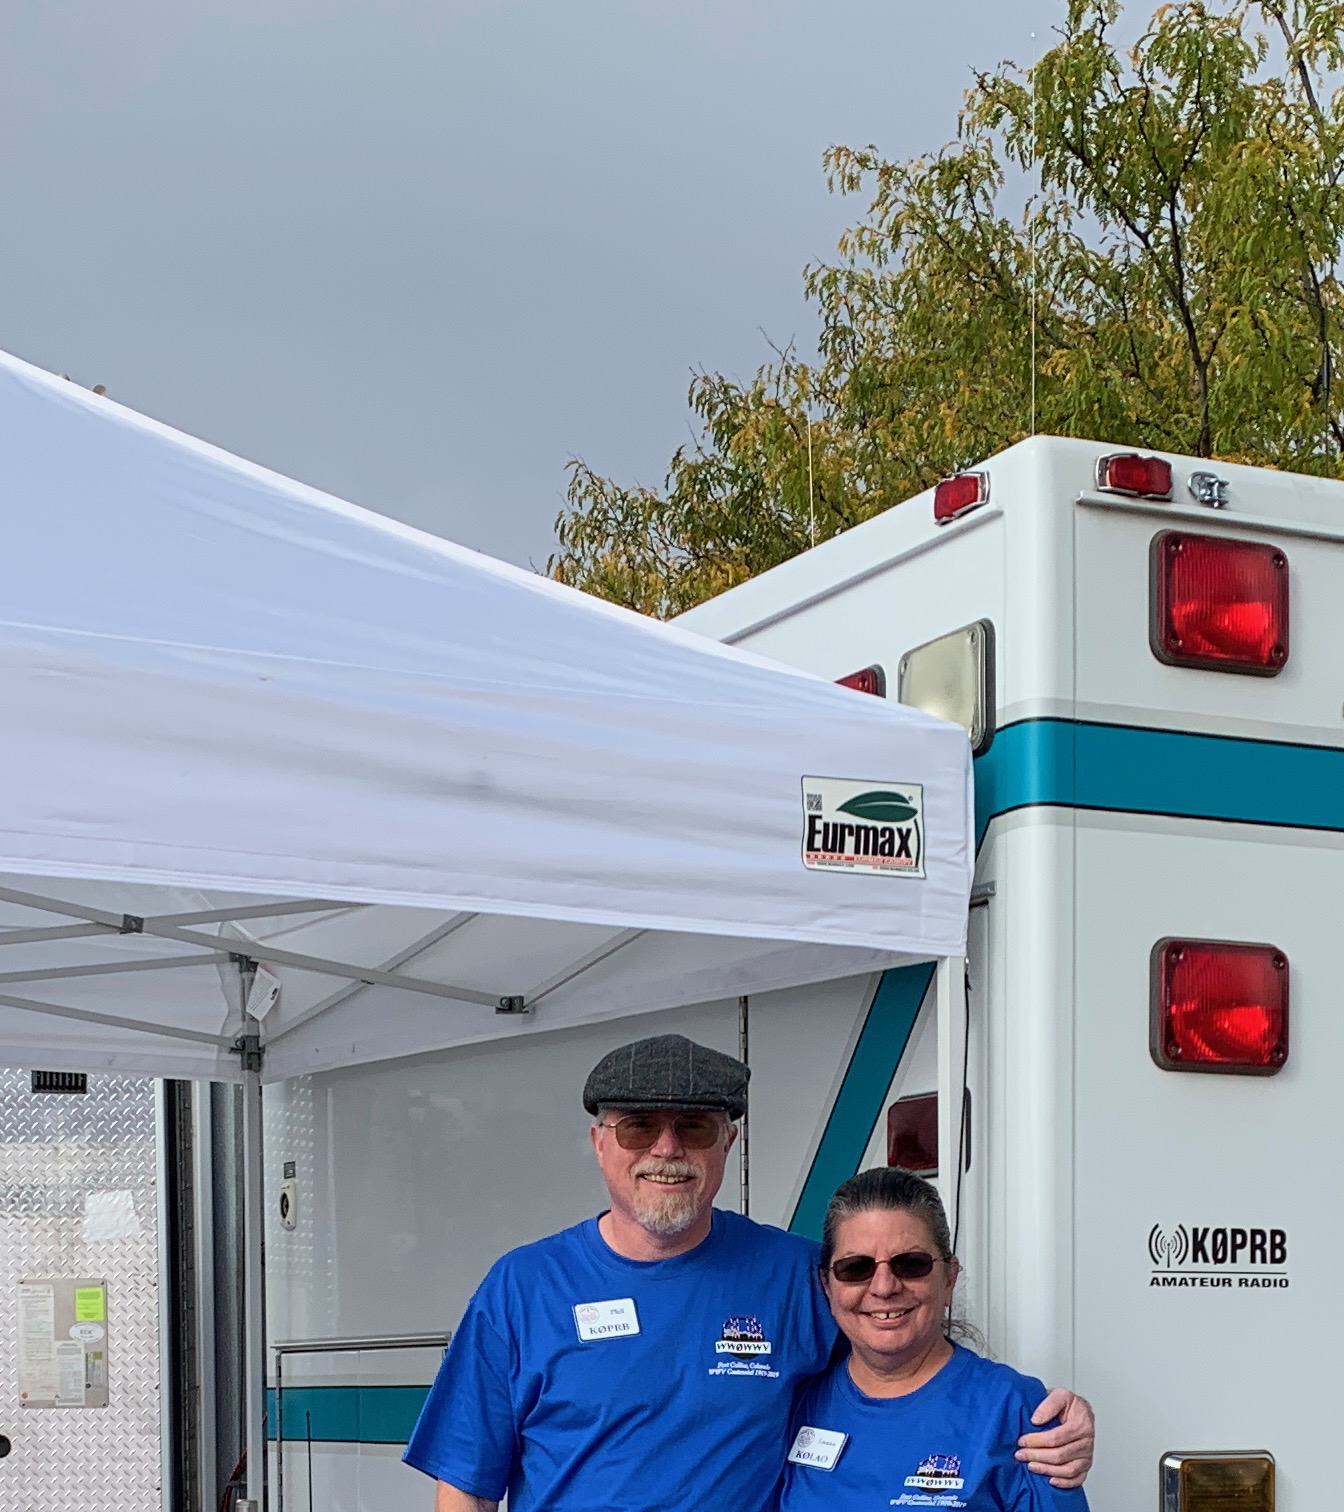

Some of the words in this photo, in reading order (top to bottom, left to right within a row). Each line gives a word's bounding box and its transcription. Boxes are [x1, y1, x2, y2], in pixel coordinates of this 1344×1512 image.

[806, 814, 912, 858] Eurmax
[1149, 1277, 1232, 1288] AMATEUR
[1238, 1278, 1290, 1288] RADIO
